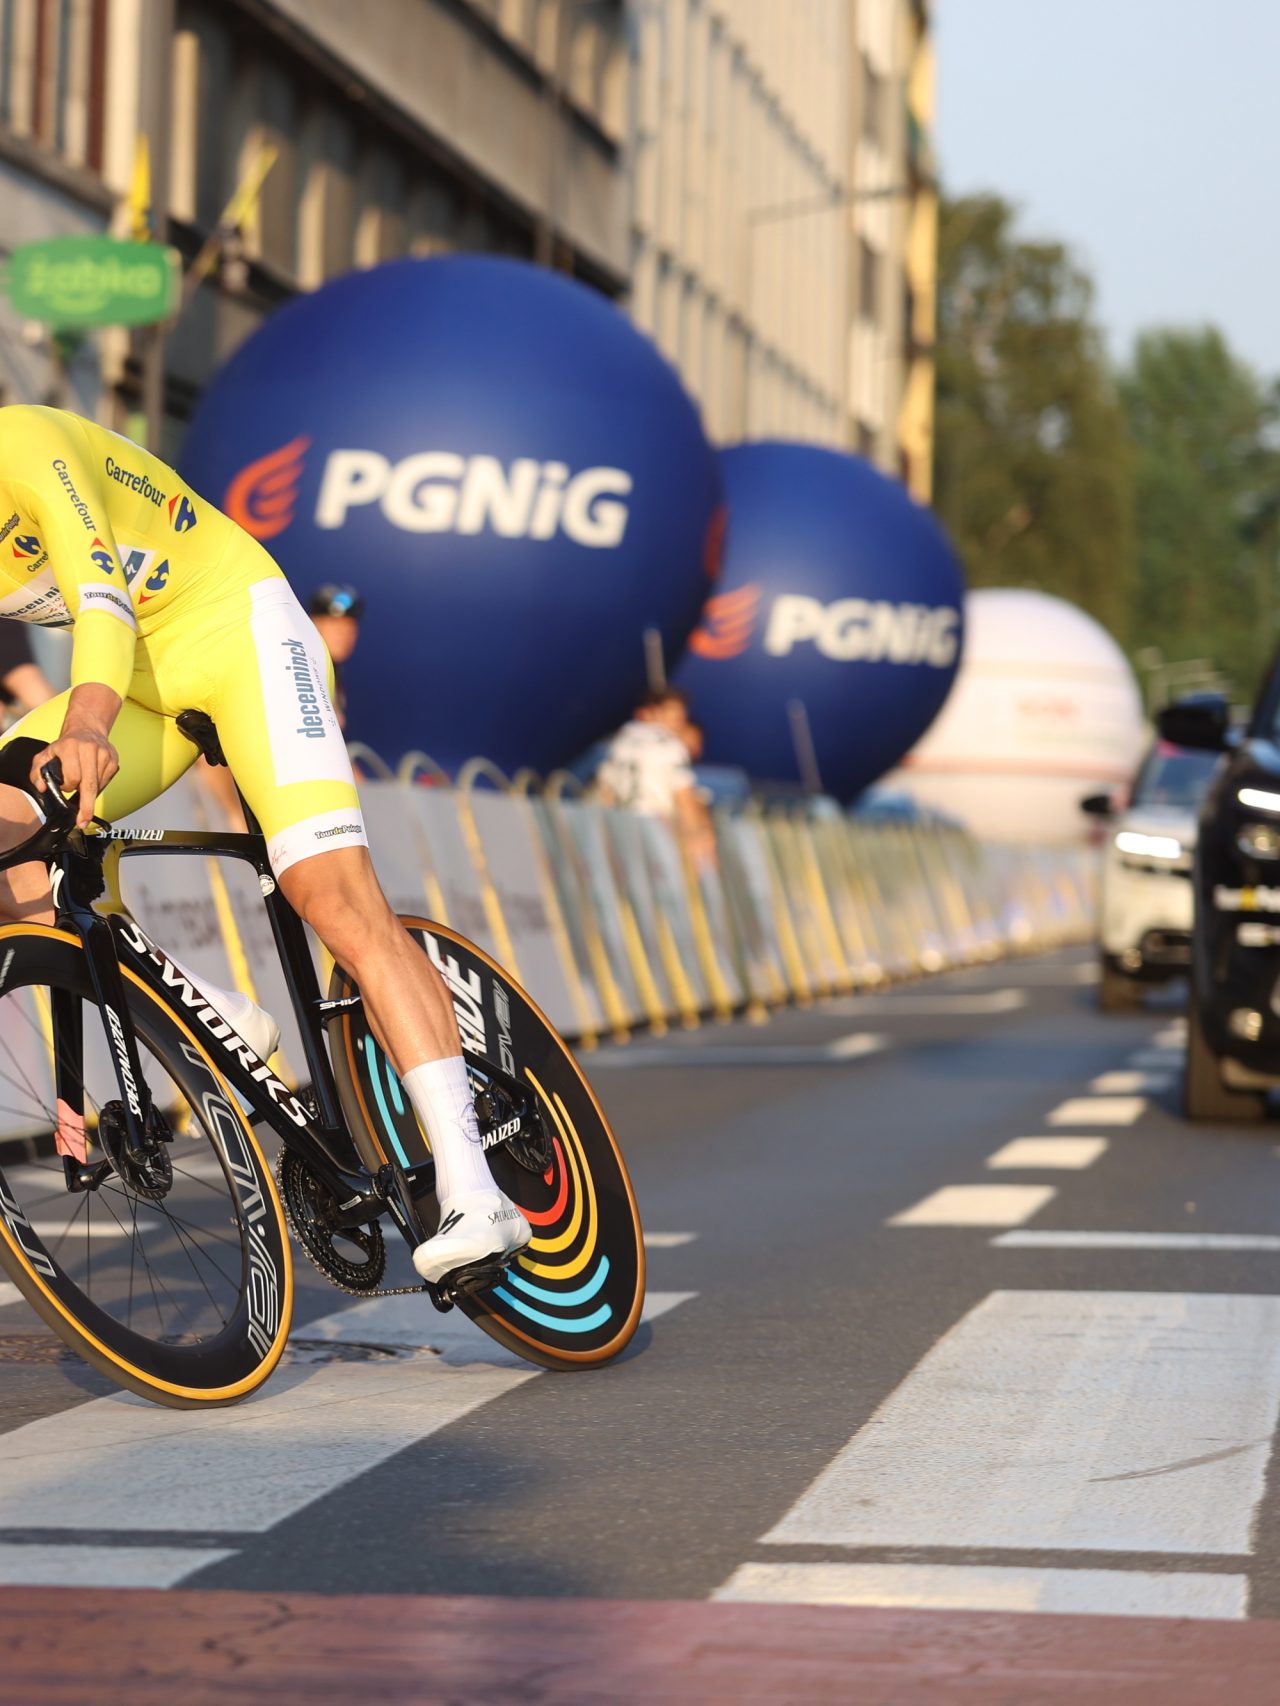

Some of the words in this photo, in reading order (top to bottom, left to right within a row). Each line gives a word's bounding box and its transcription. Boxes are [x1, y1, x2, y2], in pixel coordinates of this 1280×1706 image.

[52, 459, 97, 532] Carrefour
[105, 456, 166, 508] Carrefour
[315, 447, 633, 550] PGNiG
[764, 594, 960, 669] PGNiG
[281, 638, 326, 739] deceuninck
[120, 921, 317, 1128] S-WORKS
